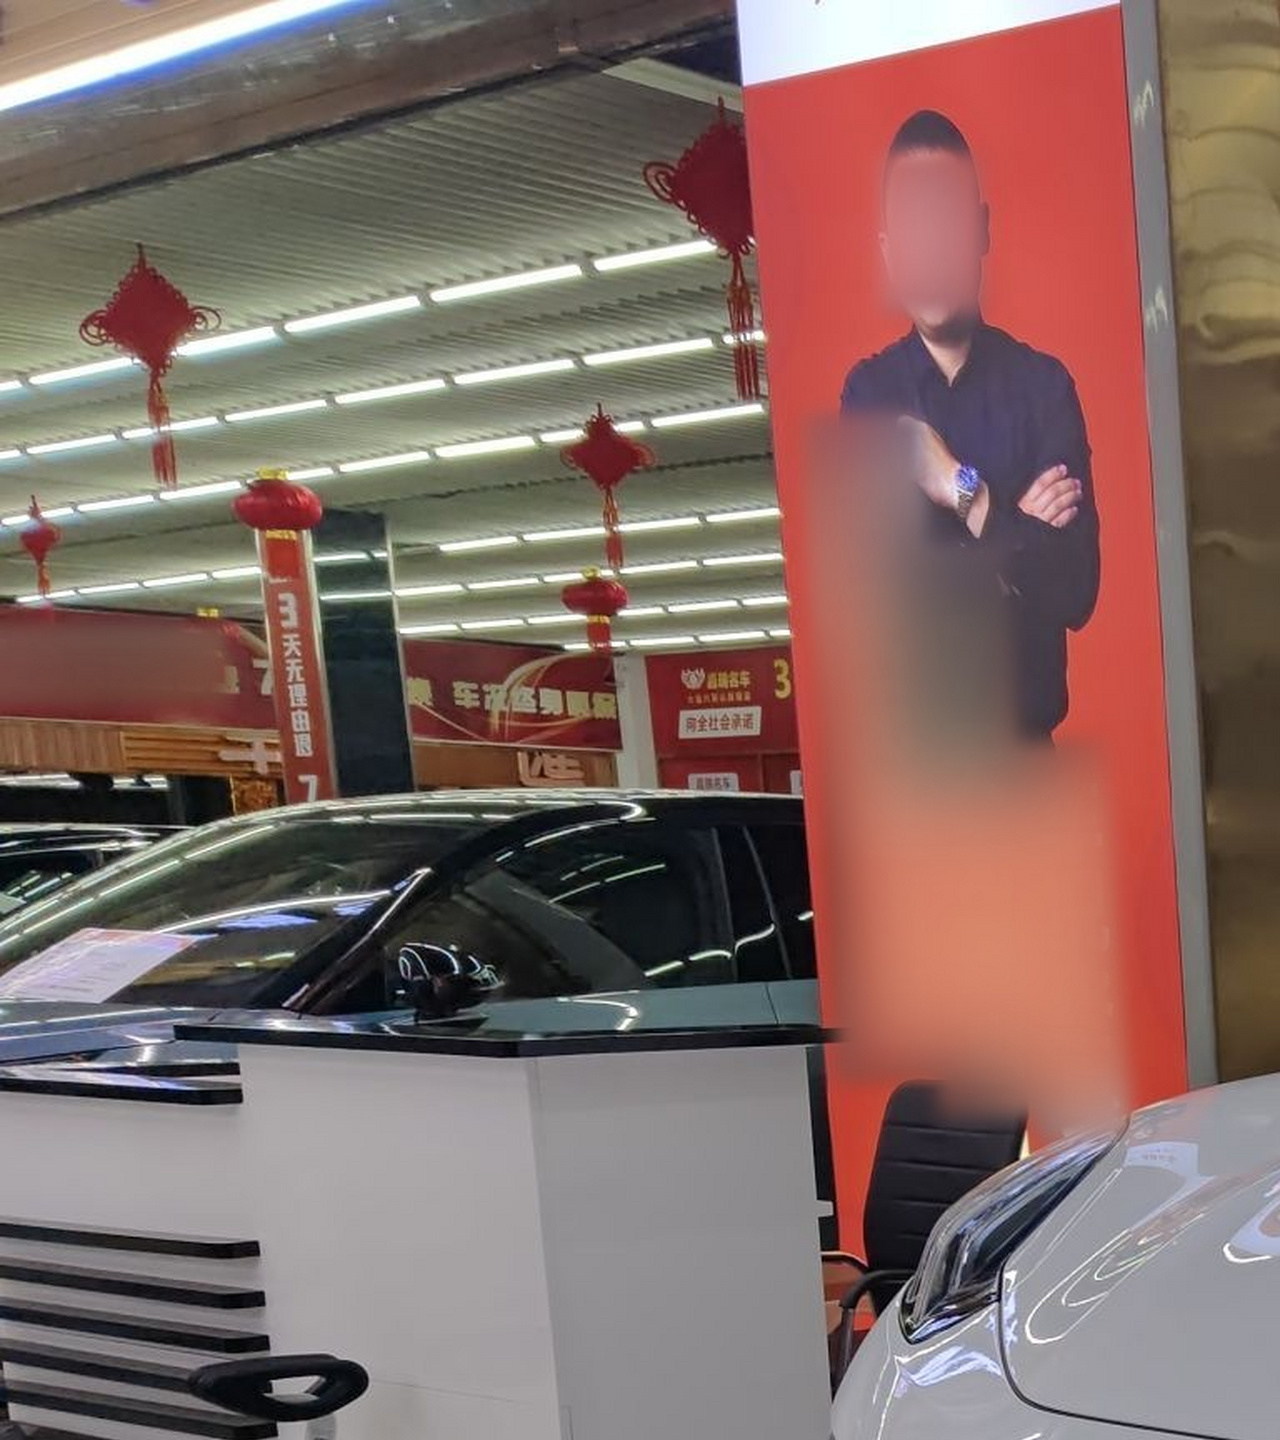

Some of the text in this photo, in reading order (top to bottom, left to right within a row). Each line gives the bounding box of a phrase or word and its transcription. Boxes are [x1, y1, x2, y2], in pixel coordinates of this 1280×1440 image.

[686, 713, 754, 733] 向全社会承诺
